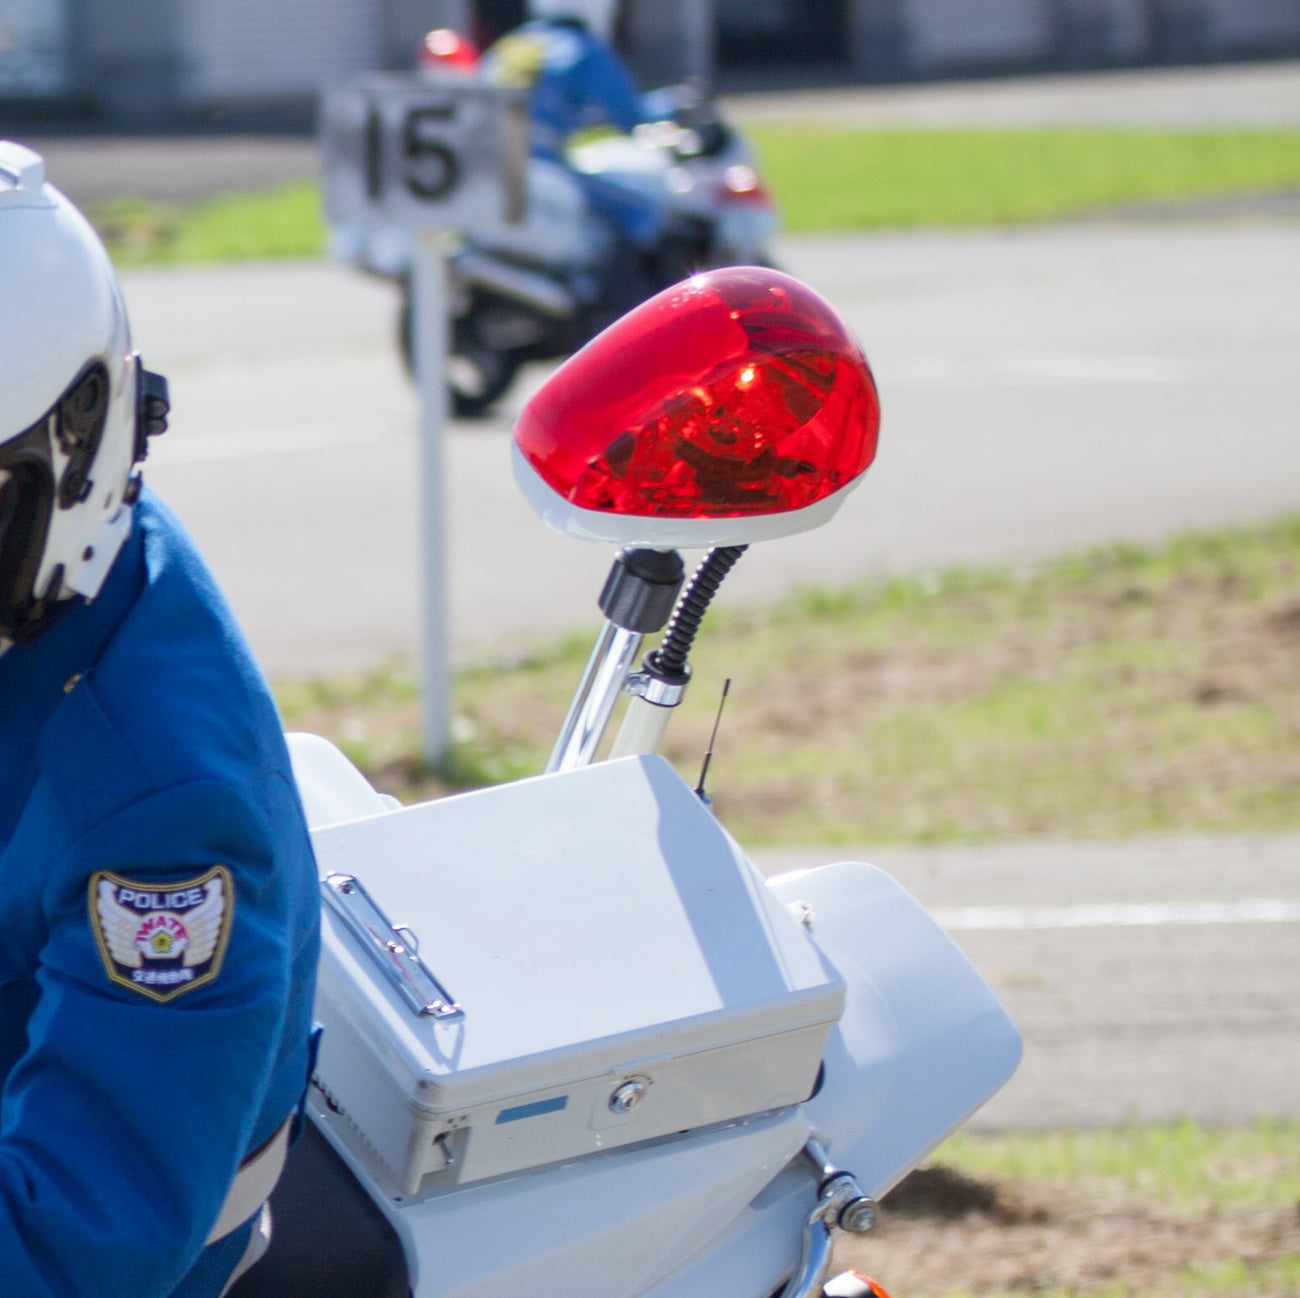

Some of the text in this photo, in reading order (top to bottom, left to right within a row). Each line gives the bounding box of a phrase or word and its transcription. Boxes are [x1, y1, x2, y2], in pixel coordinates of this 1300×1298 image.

[362, 102, 463, 205] 15
[118, 887, 205, 909] POLICE
[135, 915, 189, 942] IWATE
